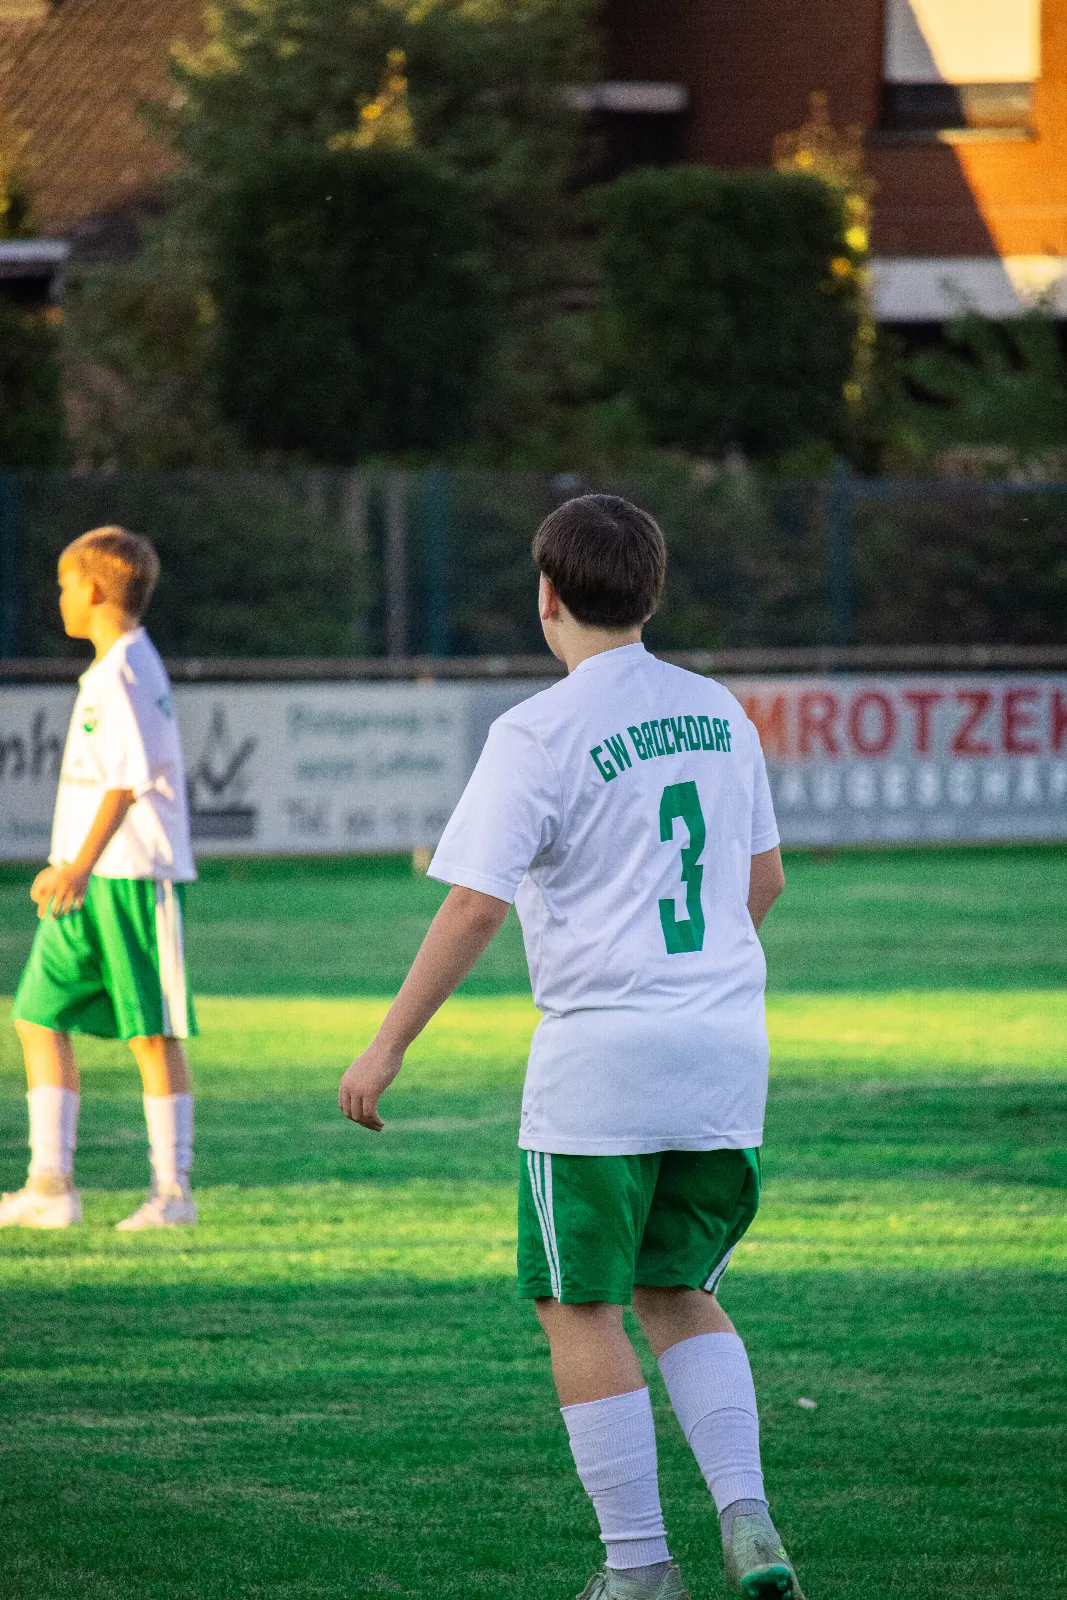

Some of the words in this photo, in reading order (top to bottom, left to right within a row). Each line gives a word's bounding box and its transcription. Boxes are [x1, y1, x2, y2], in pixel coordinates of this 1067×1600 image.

[590, 733, 633, 783] GW
[626, 715, 732, 761] BROCKDORF
[657, 780, 706, 955] 3
